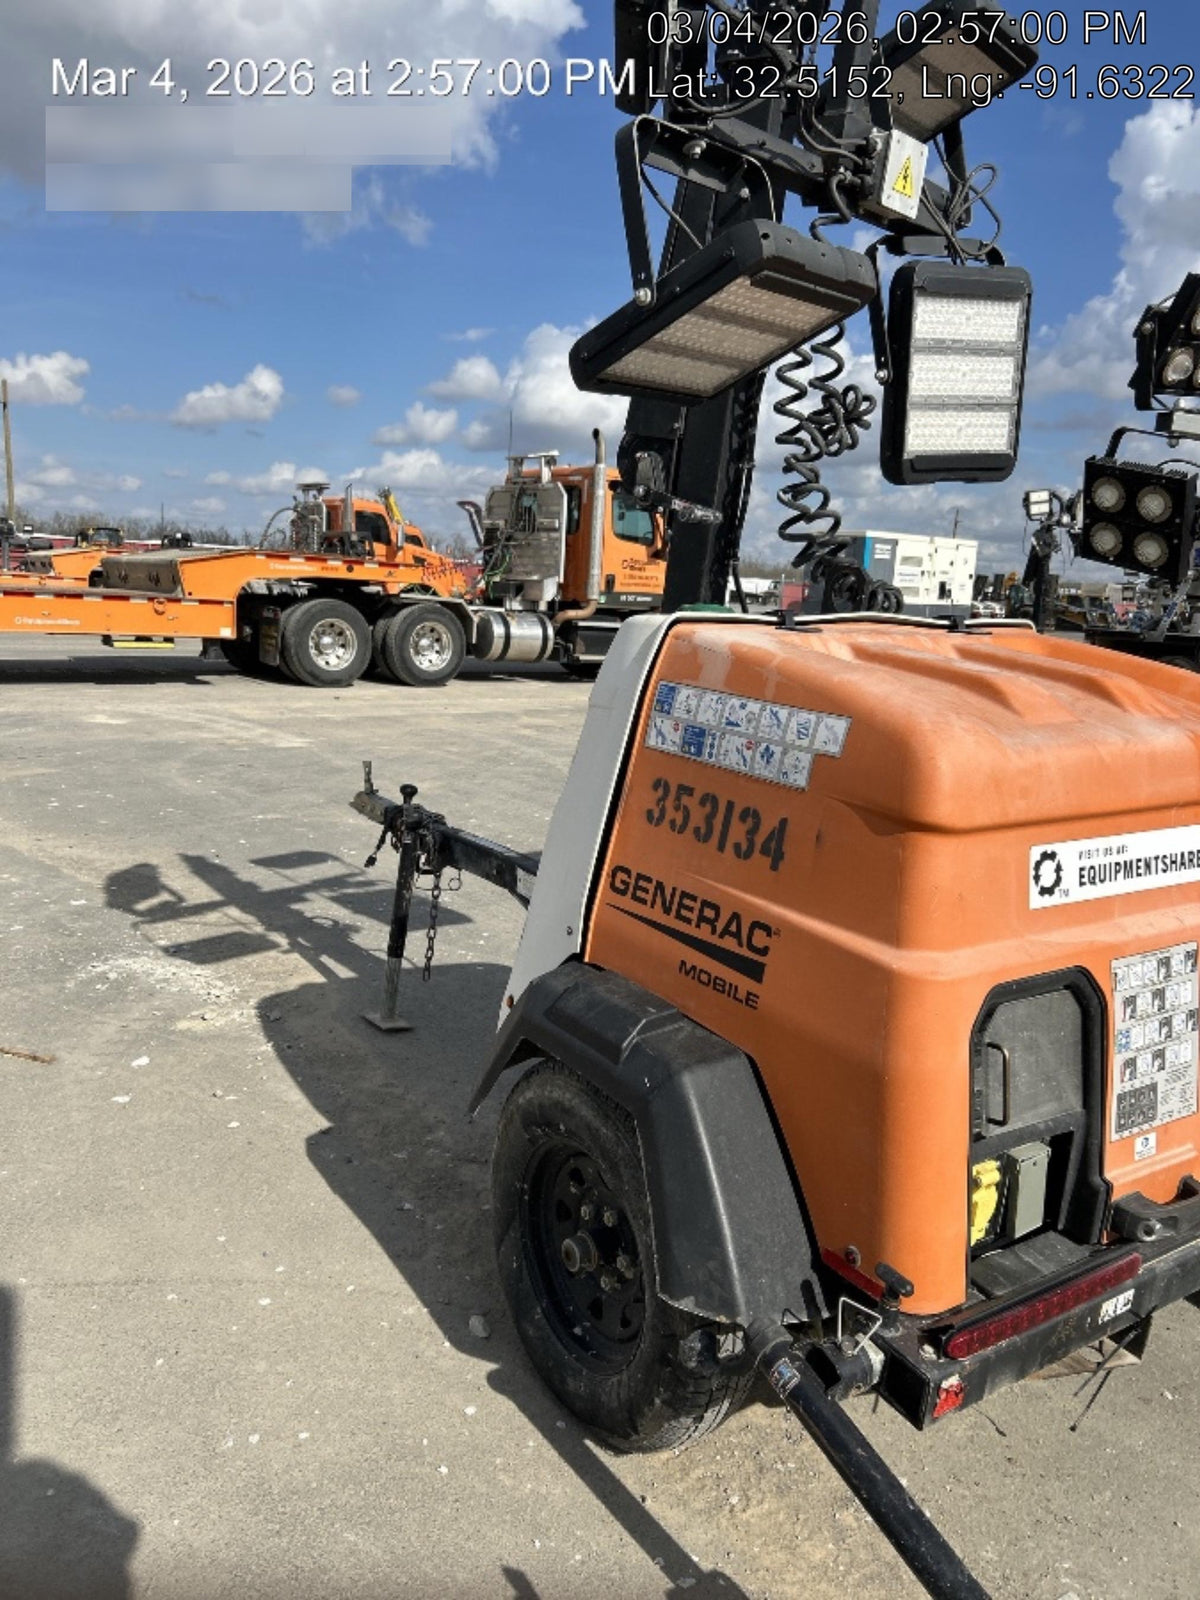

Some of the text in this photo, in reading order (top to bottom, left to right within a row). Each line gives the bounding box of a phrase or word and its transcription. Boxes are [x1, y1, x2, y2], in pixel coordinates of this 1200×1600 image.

[646, 777, 788, 872] 353134
[1078, 849, 1200, 887] EQUIPMENTSHARE
[609, 865, 773, 957] GENERAC
[678, 959, 760, 1011] MOBILE
